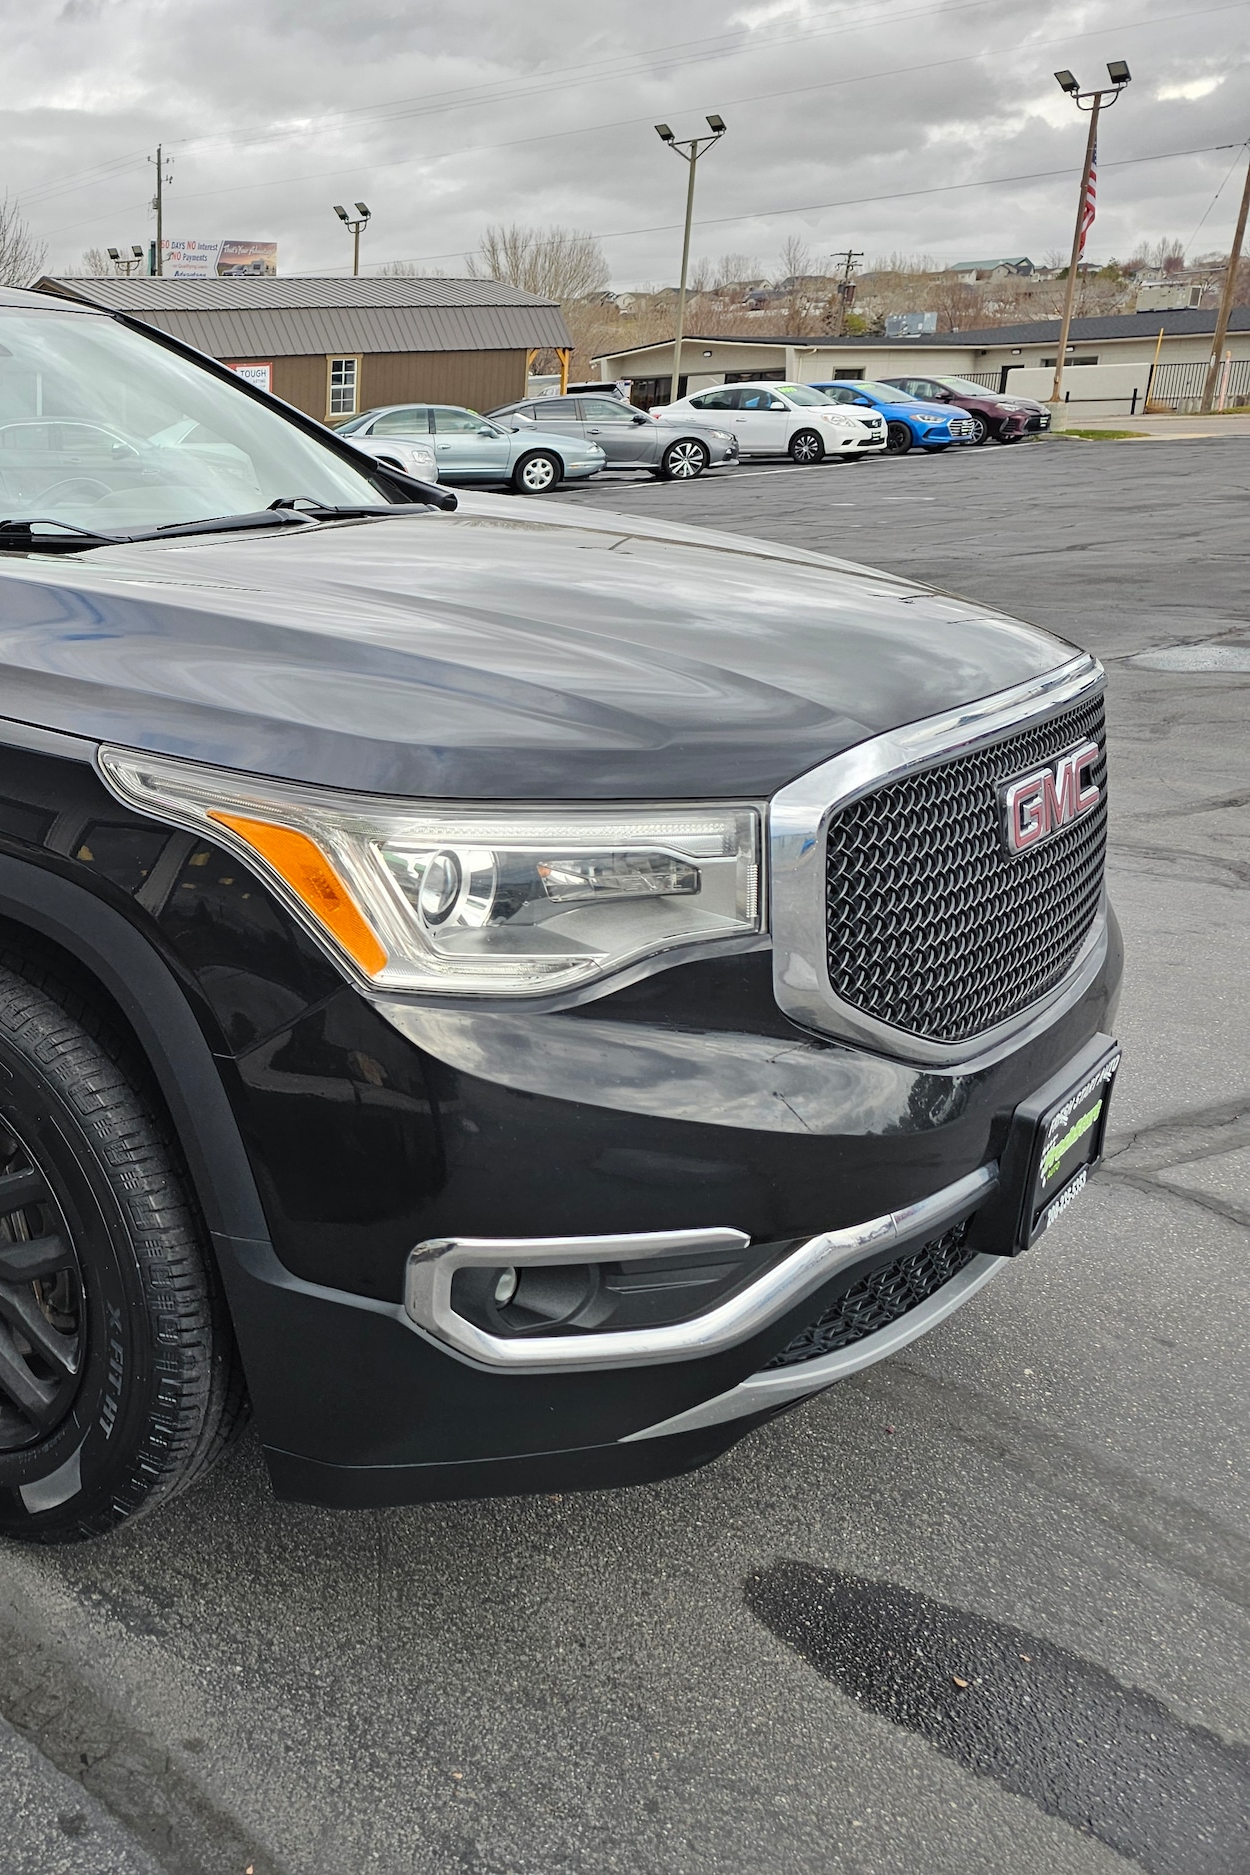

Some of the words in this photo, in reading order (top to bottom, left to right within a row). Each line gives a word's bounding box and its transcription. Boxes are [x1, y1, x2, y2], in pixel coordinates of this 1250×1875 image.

[171, 241, 185, 250] DAYS
[187, 241, 196, 250] NO
[197, 243, 218, 251] Interest
[171, 252, 181, 261] NO
[183, 253, 207, 262] Payments
[240, 370, 267, 378] TOUGH
[1007, 741, 1099, 856] GMC
[109, 1338, 124, 1396] FIT
[99, 1393, 118, 1440] HT
